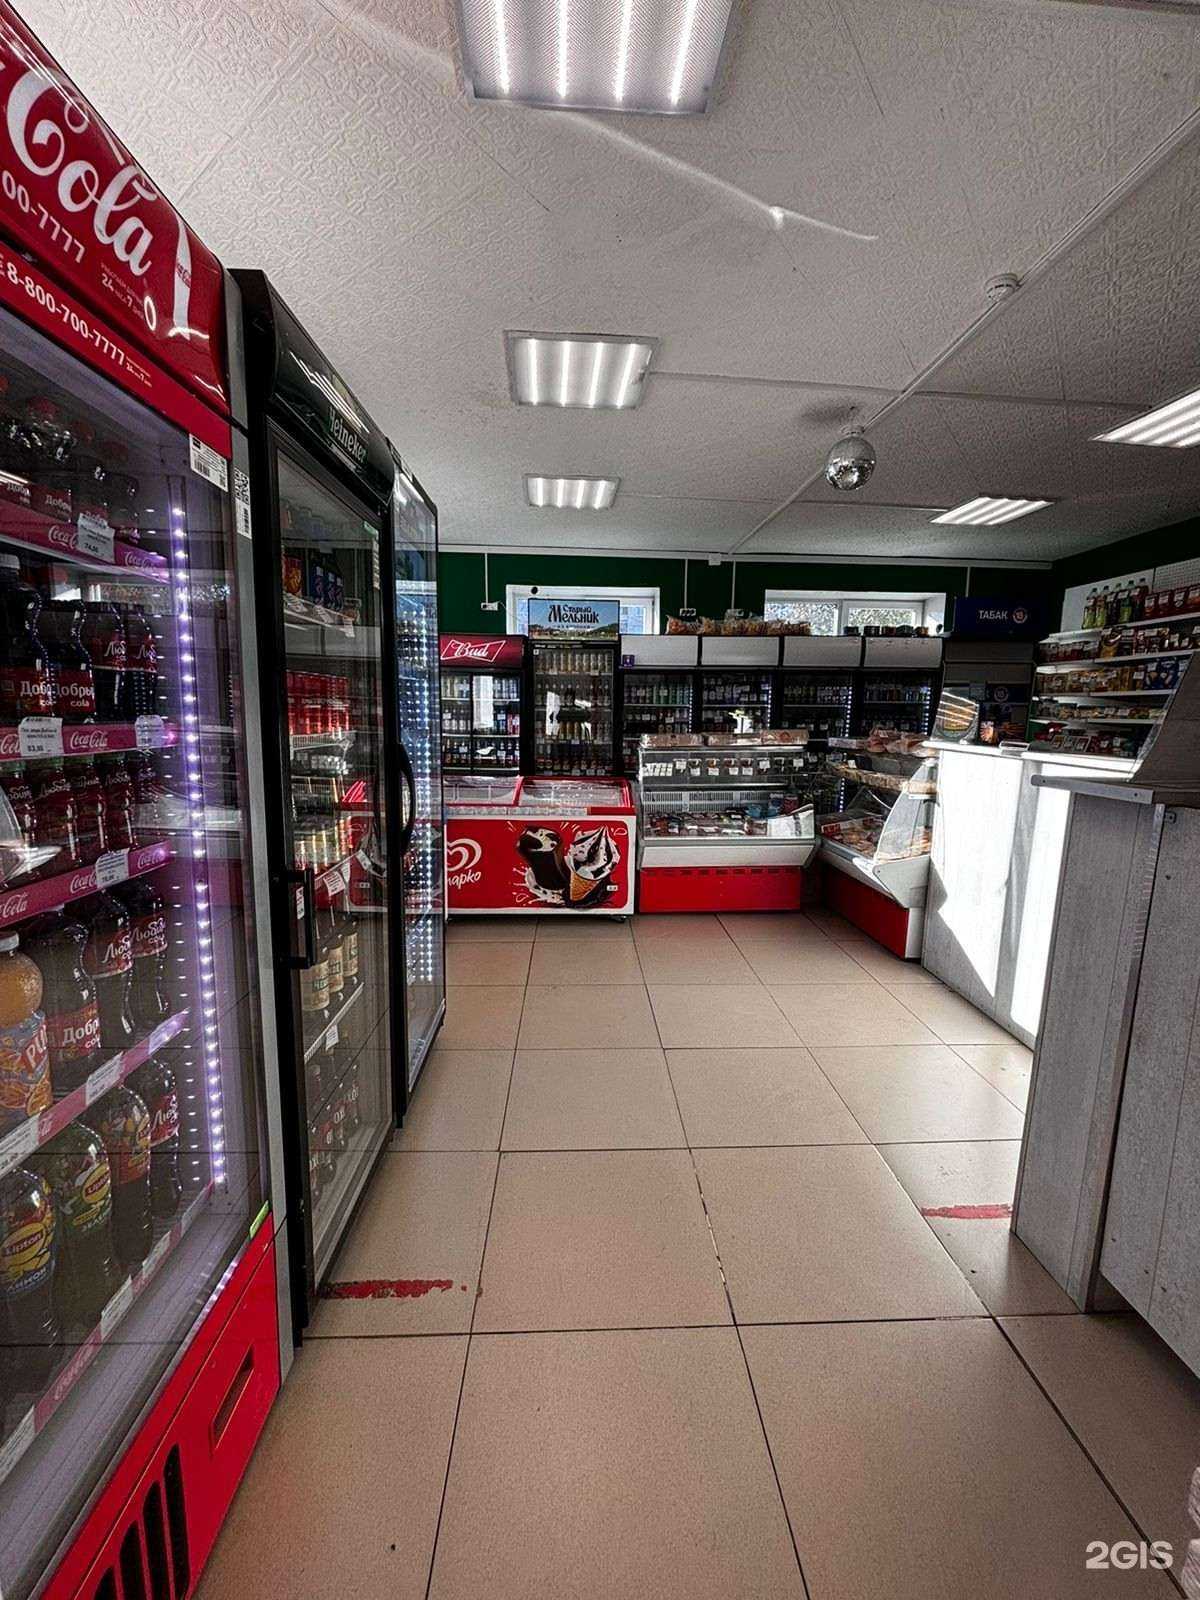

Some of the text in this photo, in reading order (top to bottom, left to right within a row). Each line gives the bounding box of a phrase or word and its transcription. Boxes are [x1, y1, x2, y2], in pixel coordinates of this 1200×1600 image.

[6, 66, 157, 277] Cola
[6, 262, 125, 366] 8-800-700-7777
[548, 604, 600, 624] Мельник
[979, 610, 1008, 620] ТАБАК
[451, 642, 489, 657] Bud
